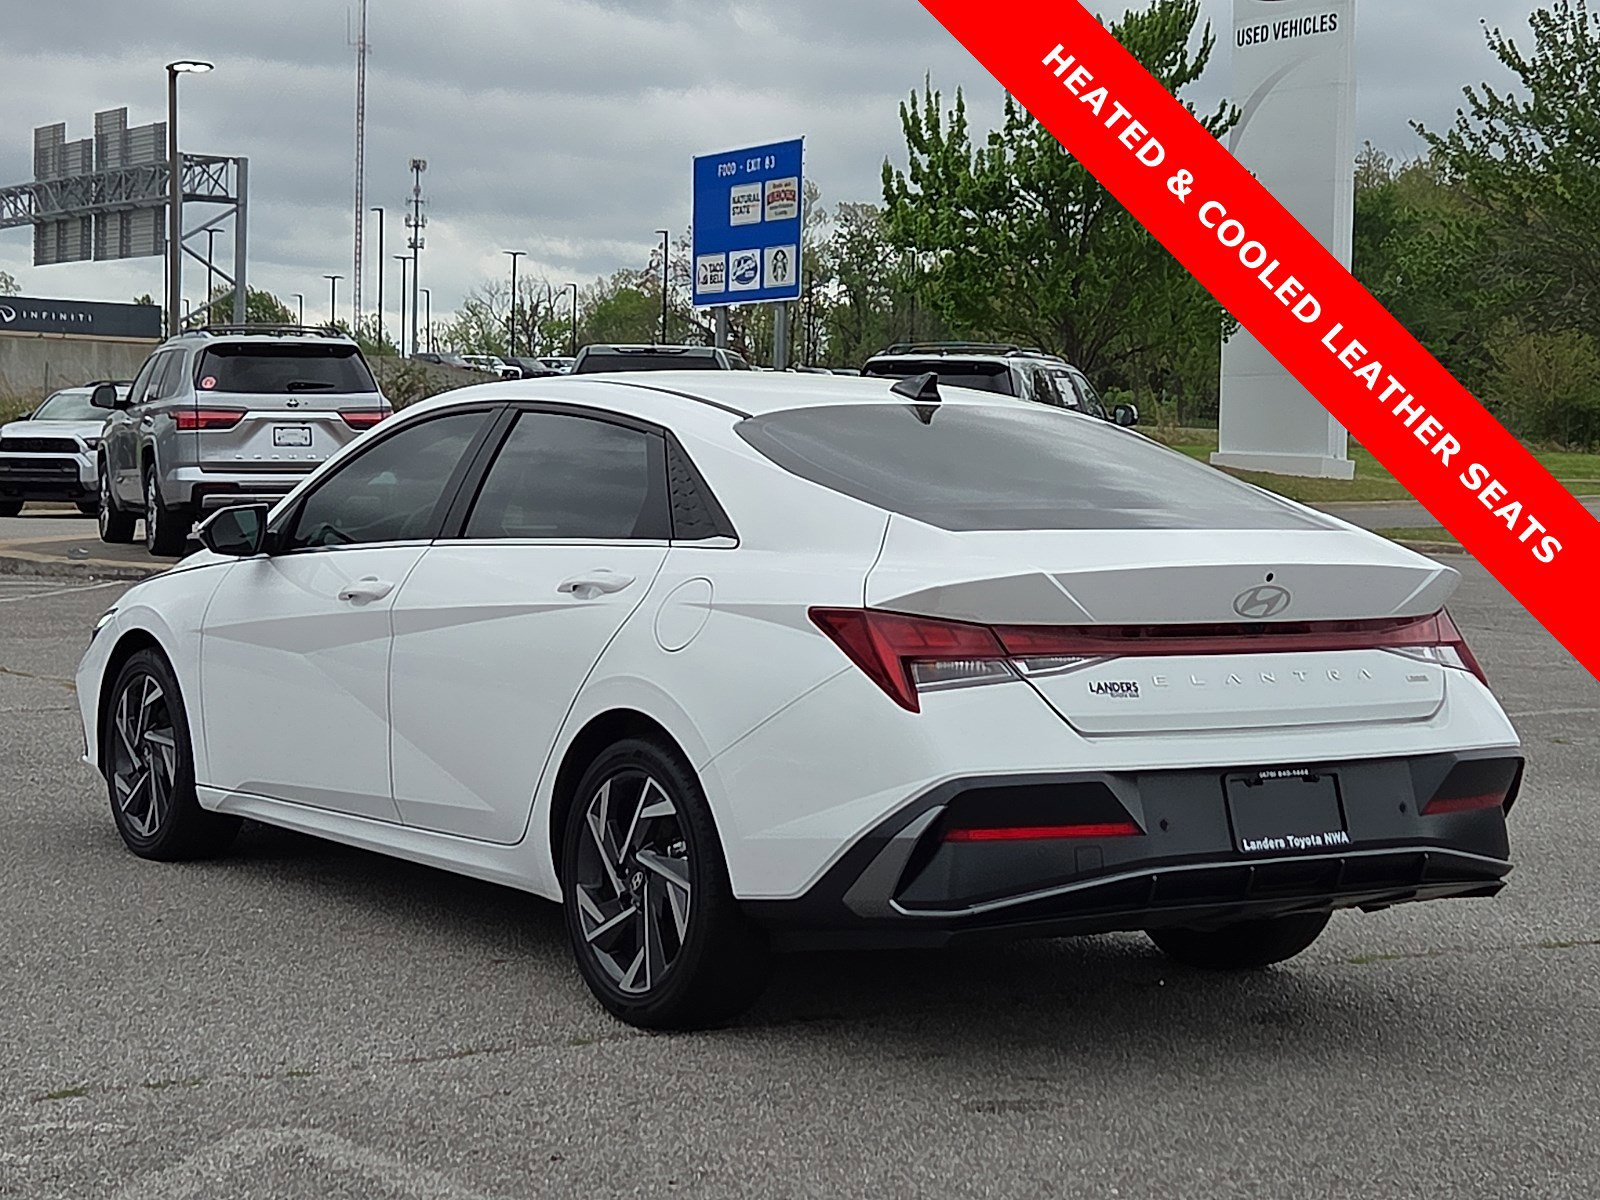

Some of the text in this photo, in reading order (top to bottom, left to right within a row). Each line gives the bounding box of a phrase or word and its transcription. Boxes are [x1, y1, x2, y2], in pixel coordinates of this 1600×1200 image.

[1236, 13, 1338, 48] USED VEHICLES
[718, 162, 736, 177] FOOD
[747, 158, 761, 172] EXIT
[732, 193, 760, 204] NATURAL
[732, 205, 750, 216] STATE
[708, 261, 725, 273] TACO
[709, 273, 723, 284] BELL
[22, 310, 94, 323] INFINITI
[1152, 668, 1372, 687] ELANTRA
[1088, 681, 1139, 694] LANDERS
[1242, 830, 1350, 852] Landers Toyota NWA
